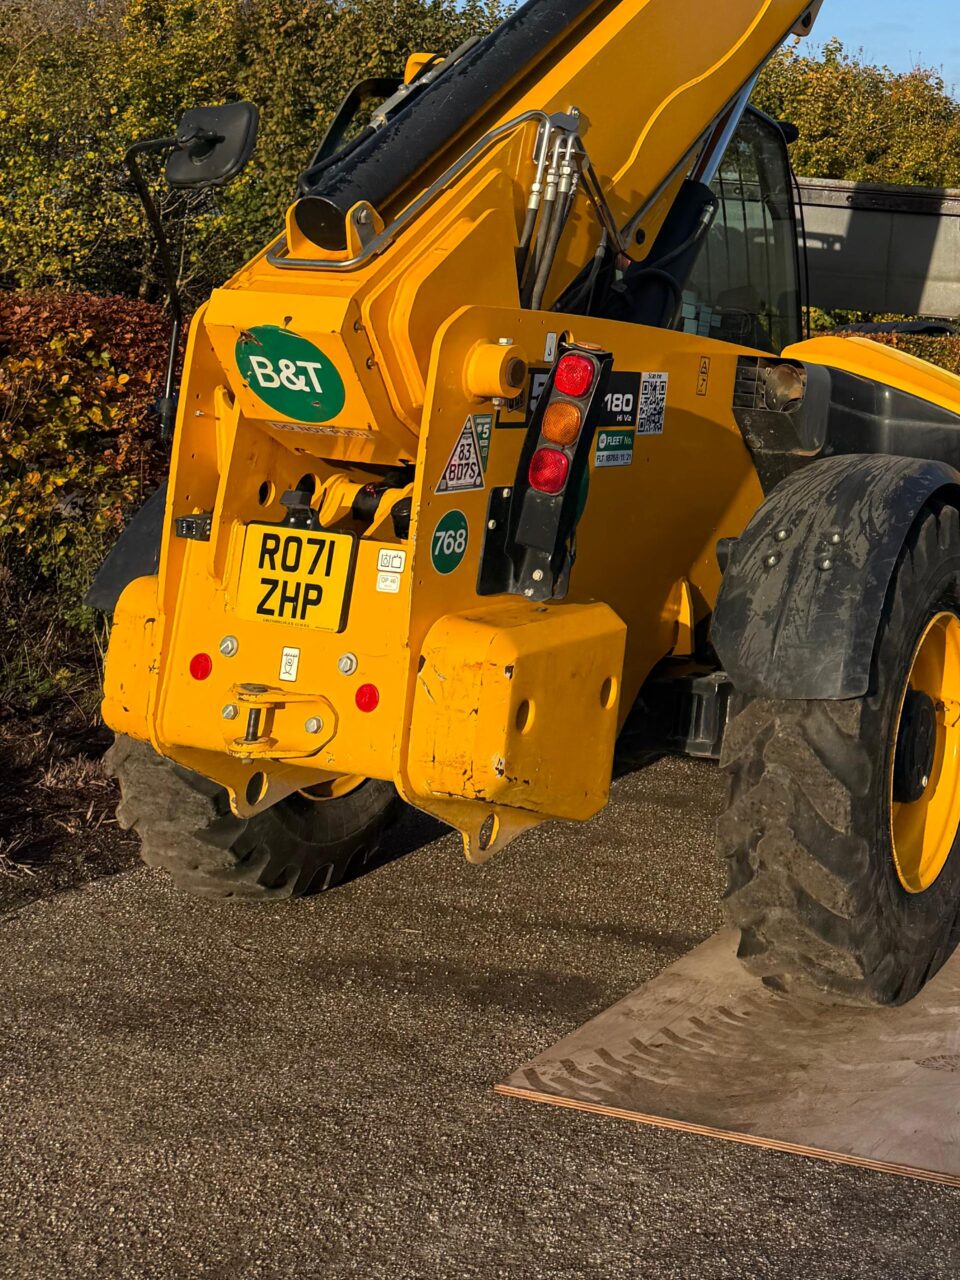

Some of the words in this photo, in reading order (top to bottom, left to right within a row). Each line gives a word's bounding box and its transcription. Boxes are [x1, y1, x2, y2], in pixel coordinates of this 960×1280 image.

[249, 355, 323, 393] B&T
[604, 393, 633, 412] 180
[458, 443, 472, 461] 83
[607, 436, 623, 446] FLEET
[258, 533, 336, 577] RO71
[434, 529, 467, 556] 768
[256, 577, 323, 621] ZHP
